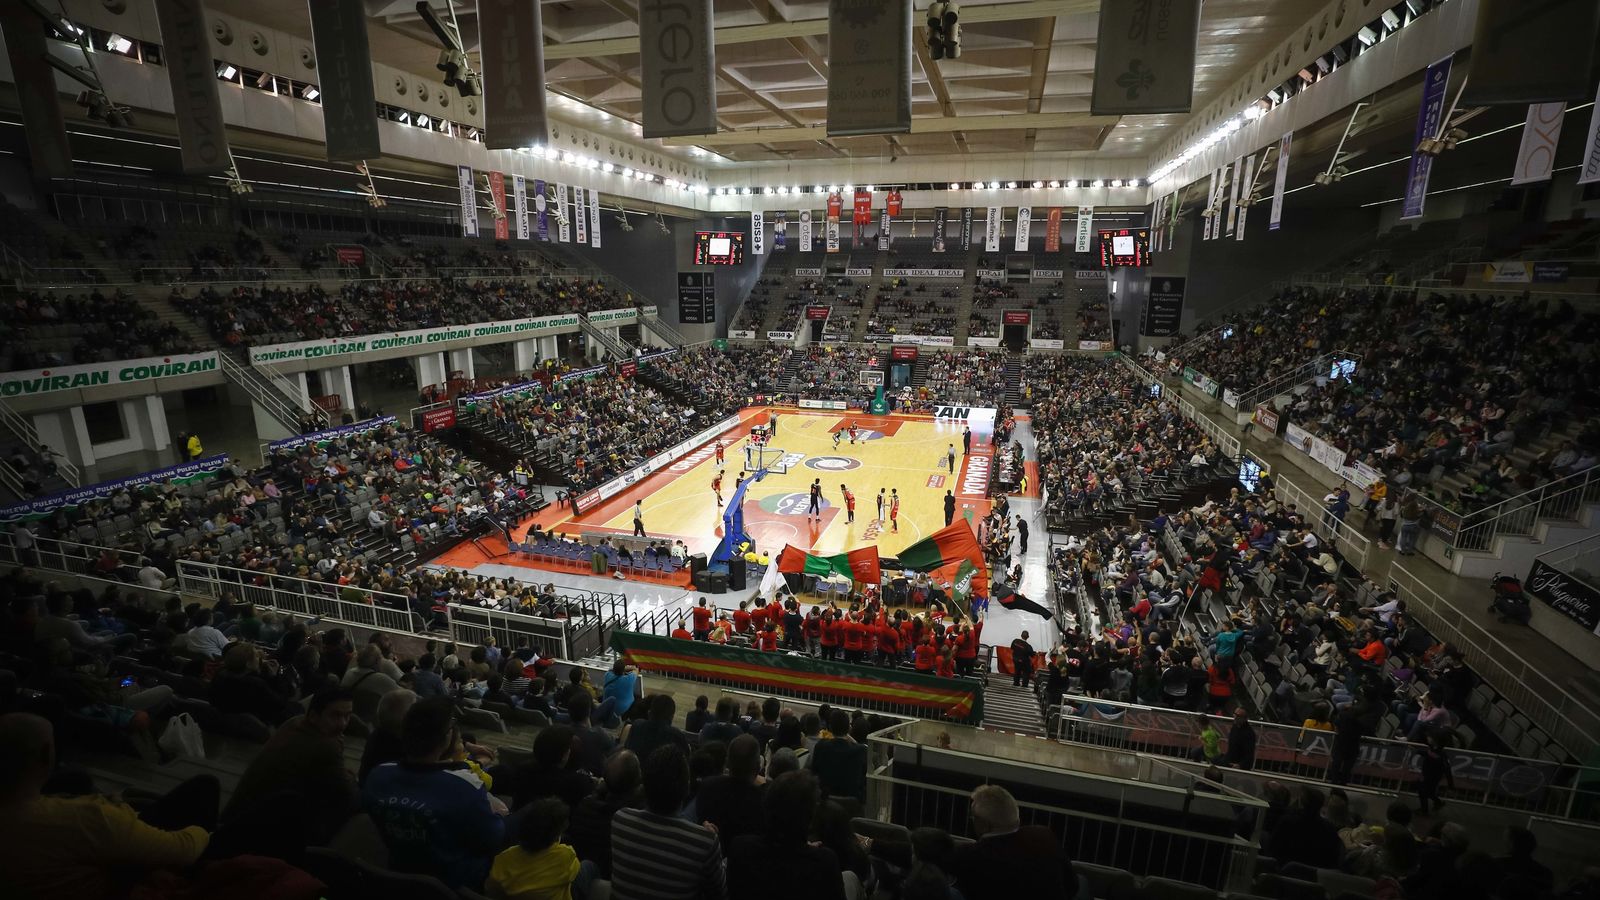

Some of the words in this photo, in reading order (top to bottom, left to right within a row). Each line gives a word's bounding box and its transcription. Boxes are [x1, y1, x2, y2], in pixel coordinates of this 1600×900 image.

[575, 188, 584, 231] BERNER
[801, 225, 809, 251] otero
[1078, 217, 1089, 251] fertisac
[589, 312, 614, 322] COVIRAN
[615, 309, 637, 319] COVIRAN
[304, 340, 366, 357] COVIRAN
[371, 333, 423, 350] COVIRAN
[427, 328, 471, 342] COVIRAN
[474, 323, 512, 336] COVIRAN
[514, 319, 547, 332] COVIRAN
[549, 315, 578, 327] COVIRAN
[119, 357, 216, 382] COVIRAN
[32, 496, 62, 509] PULEVA
[65, 489, 94, 501] PULEVA
[96, 482, 123, 493] PULEVA
[124, 476, 150, 487] PULEVA
[151, 469, 175, 479] PULEVA
[176, 463, 199, 474] PULEVA
[200, 458, 222, 468] PULEVA
[962, 456, 989, 495] GRANADA
